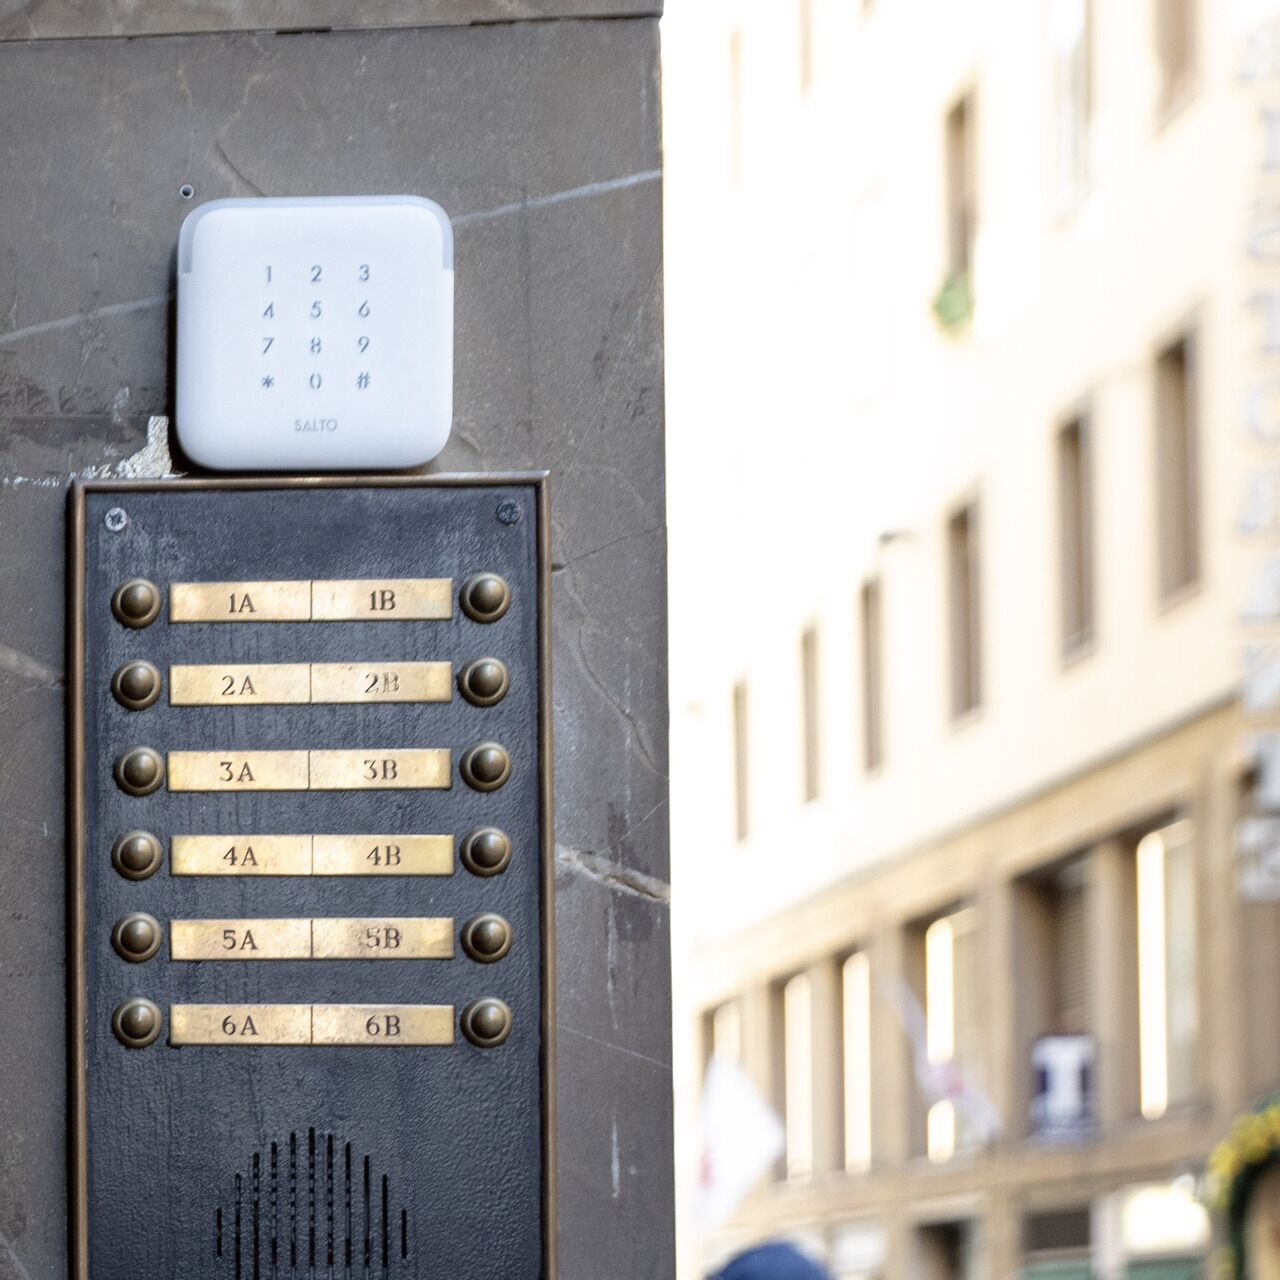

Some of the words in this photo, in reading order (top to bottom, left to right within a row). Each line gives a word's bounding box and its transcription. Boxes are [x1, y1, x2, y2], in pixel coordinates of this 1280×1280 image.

[265, 265, 272, 283] 1
[310, 265, 323, 283] 2
[359, 264, 371, 282] 3
[262, 301, 275, 319] 4
[309, 301, 322, 318] 5
[358, 301, 371, 318] 6
[262, 337, 274, 354] 7
[310, 337, 322, 354] 8
[358, 336, 370, 353] 9
[309, 373, 322, 390] 0
[357, 371, 371, 389] #
[293, 418, 338, 433] SALTO
[228, 593, 256, 614] 1A
[369, 590, 397, 611] 1B
[221, 675, 256, 696] 2A
[364, 672, 401, 694] 2B
[219, 761, 256, 782] 3A
[362, 759, 398, 780] 3B
[222, 846, 259, 867] 4A
[366, 845, 402, 867] 4B
[222, 929, 258, 951] 5A
[365, 927, 402, 949] 5B
[221, 1015, 259, 1037] 6A
[365, 1014, 401, 1037] 6B
